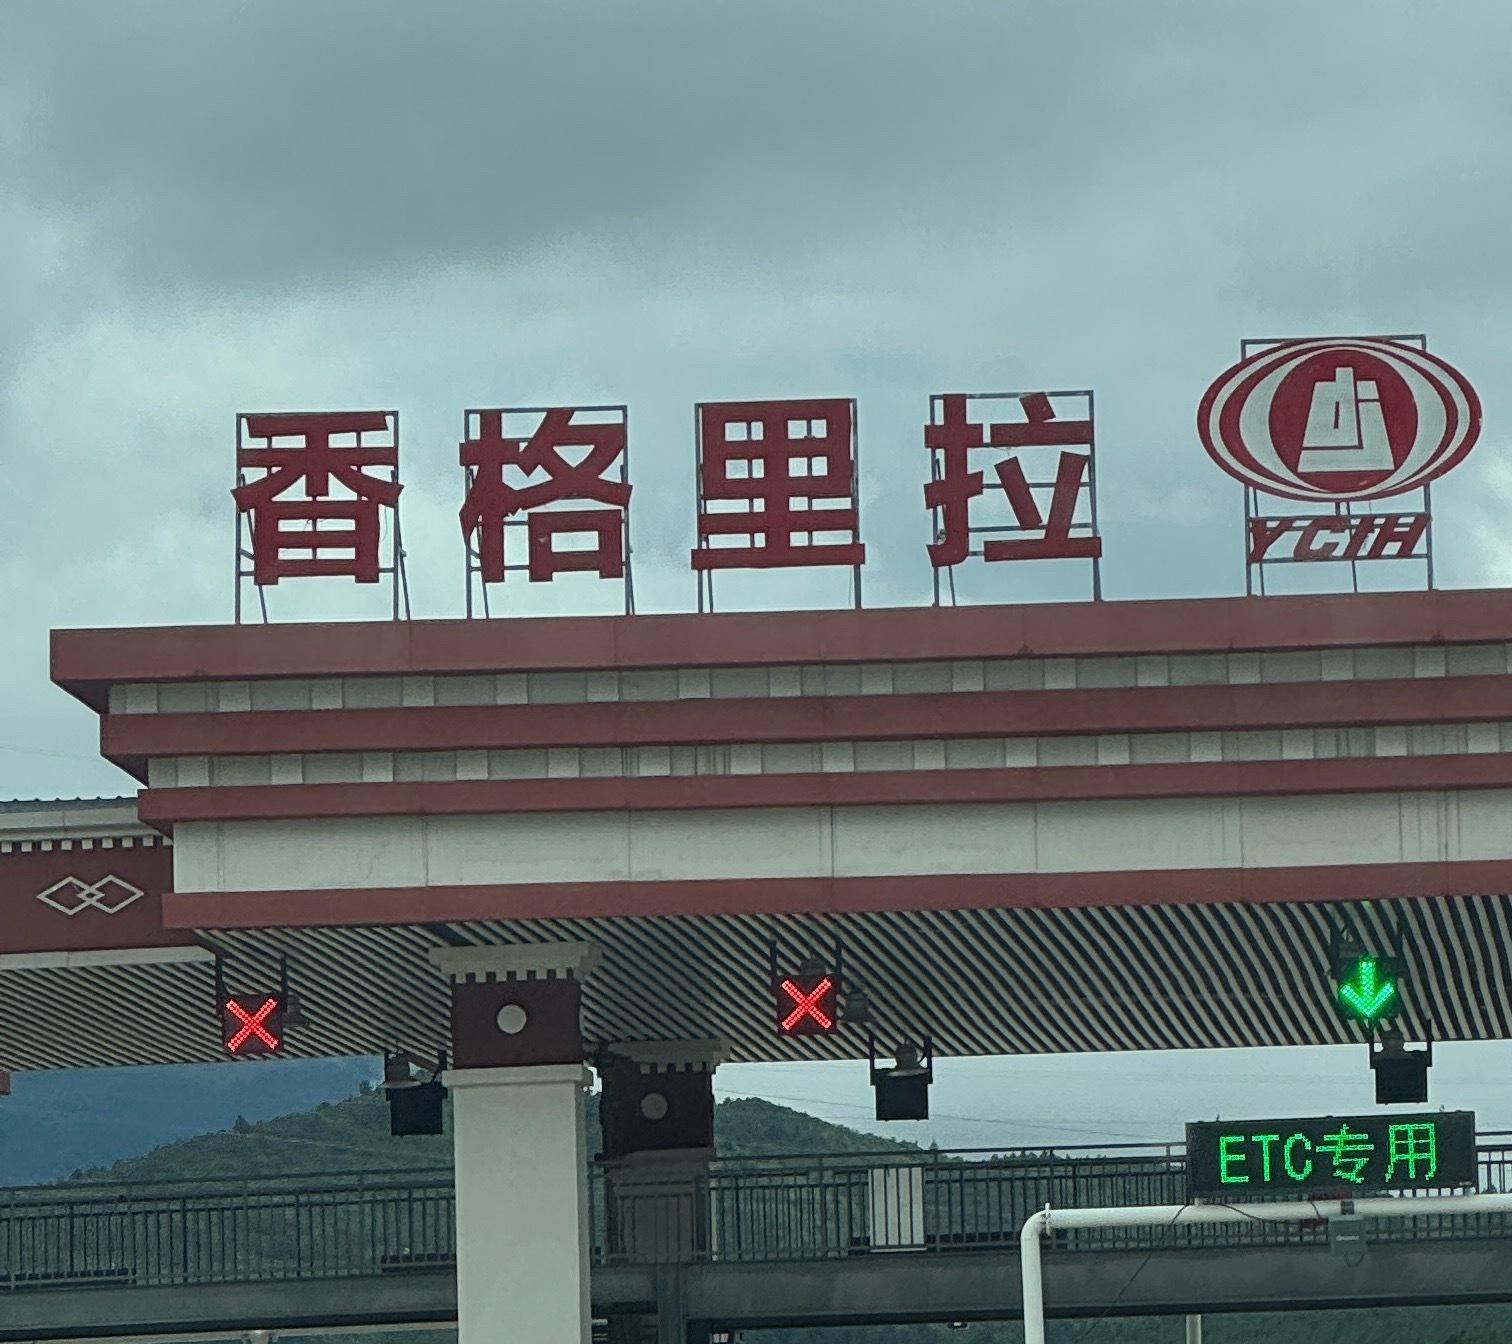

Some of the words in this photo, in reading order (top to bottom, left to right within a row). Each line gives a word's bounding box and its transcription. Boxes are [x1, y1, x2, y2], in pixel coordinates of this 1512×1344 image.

[230, 393, 1102, 586] 香格里拉
[1248, 516, 1428, 563] YCIH
[1219, 1122, 1437, 1185] ETC专用
